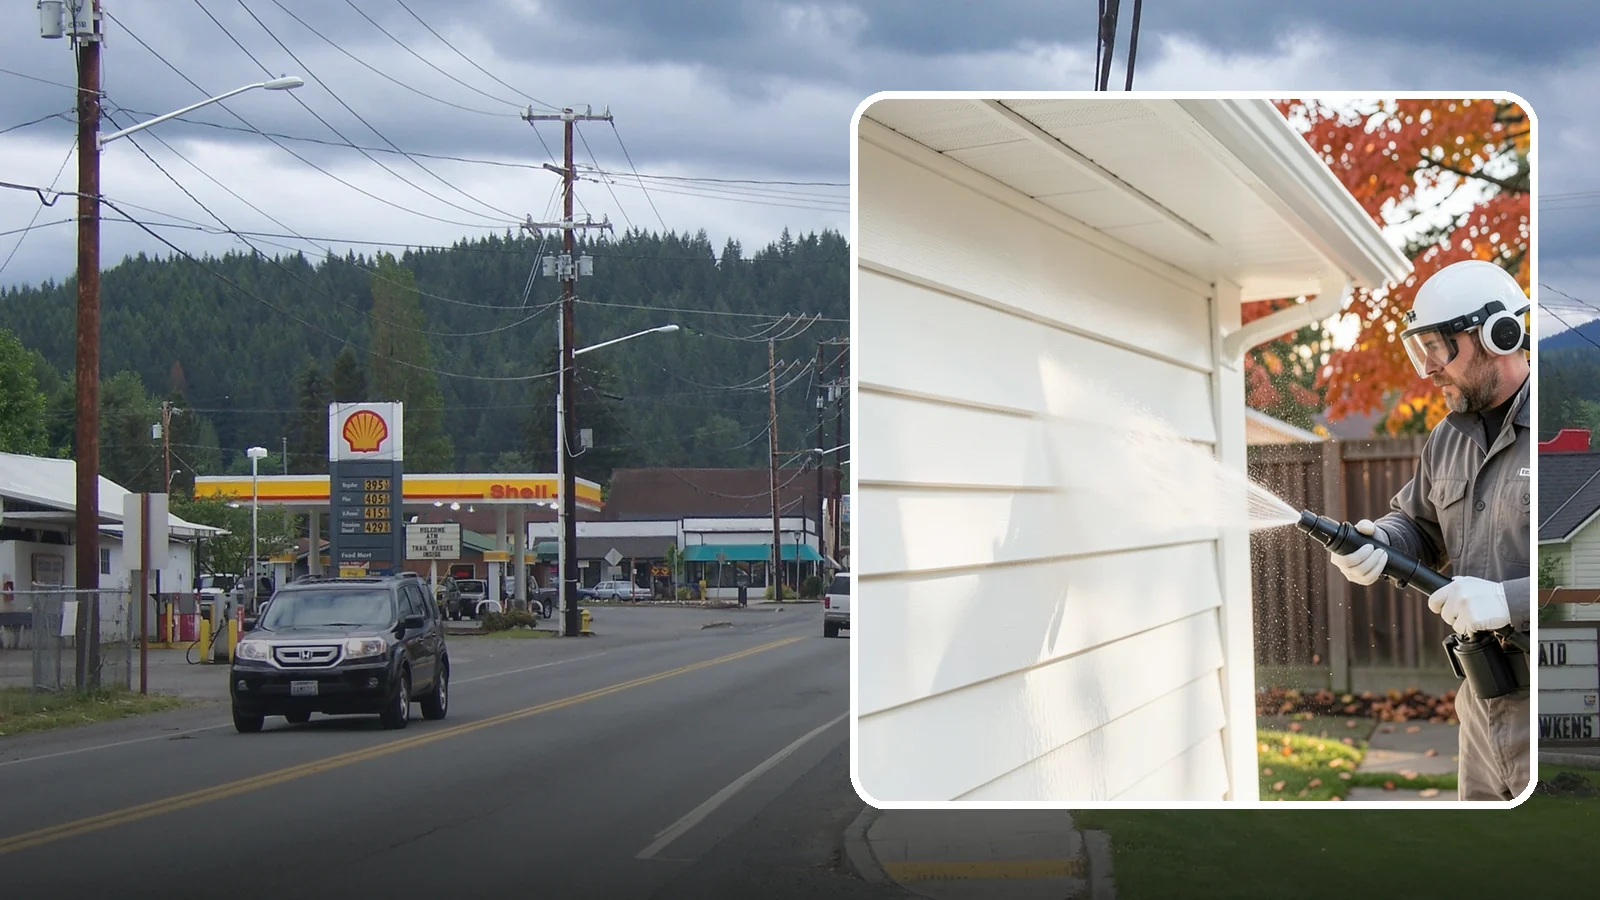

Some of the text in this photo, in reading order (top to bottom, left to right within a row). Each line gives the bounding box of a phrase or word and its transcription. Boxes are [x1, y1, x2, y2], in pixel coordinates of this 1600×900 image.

[366, 480, 383, 490] 395
[490, 484, 547, 499] Shell
[366, 494, 383, 504] 405
[366, 508, 383, 518] 415
[366, 522, 383, 533] 429
